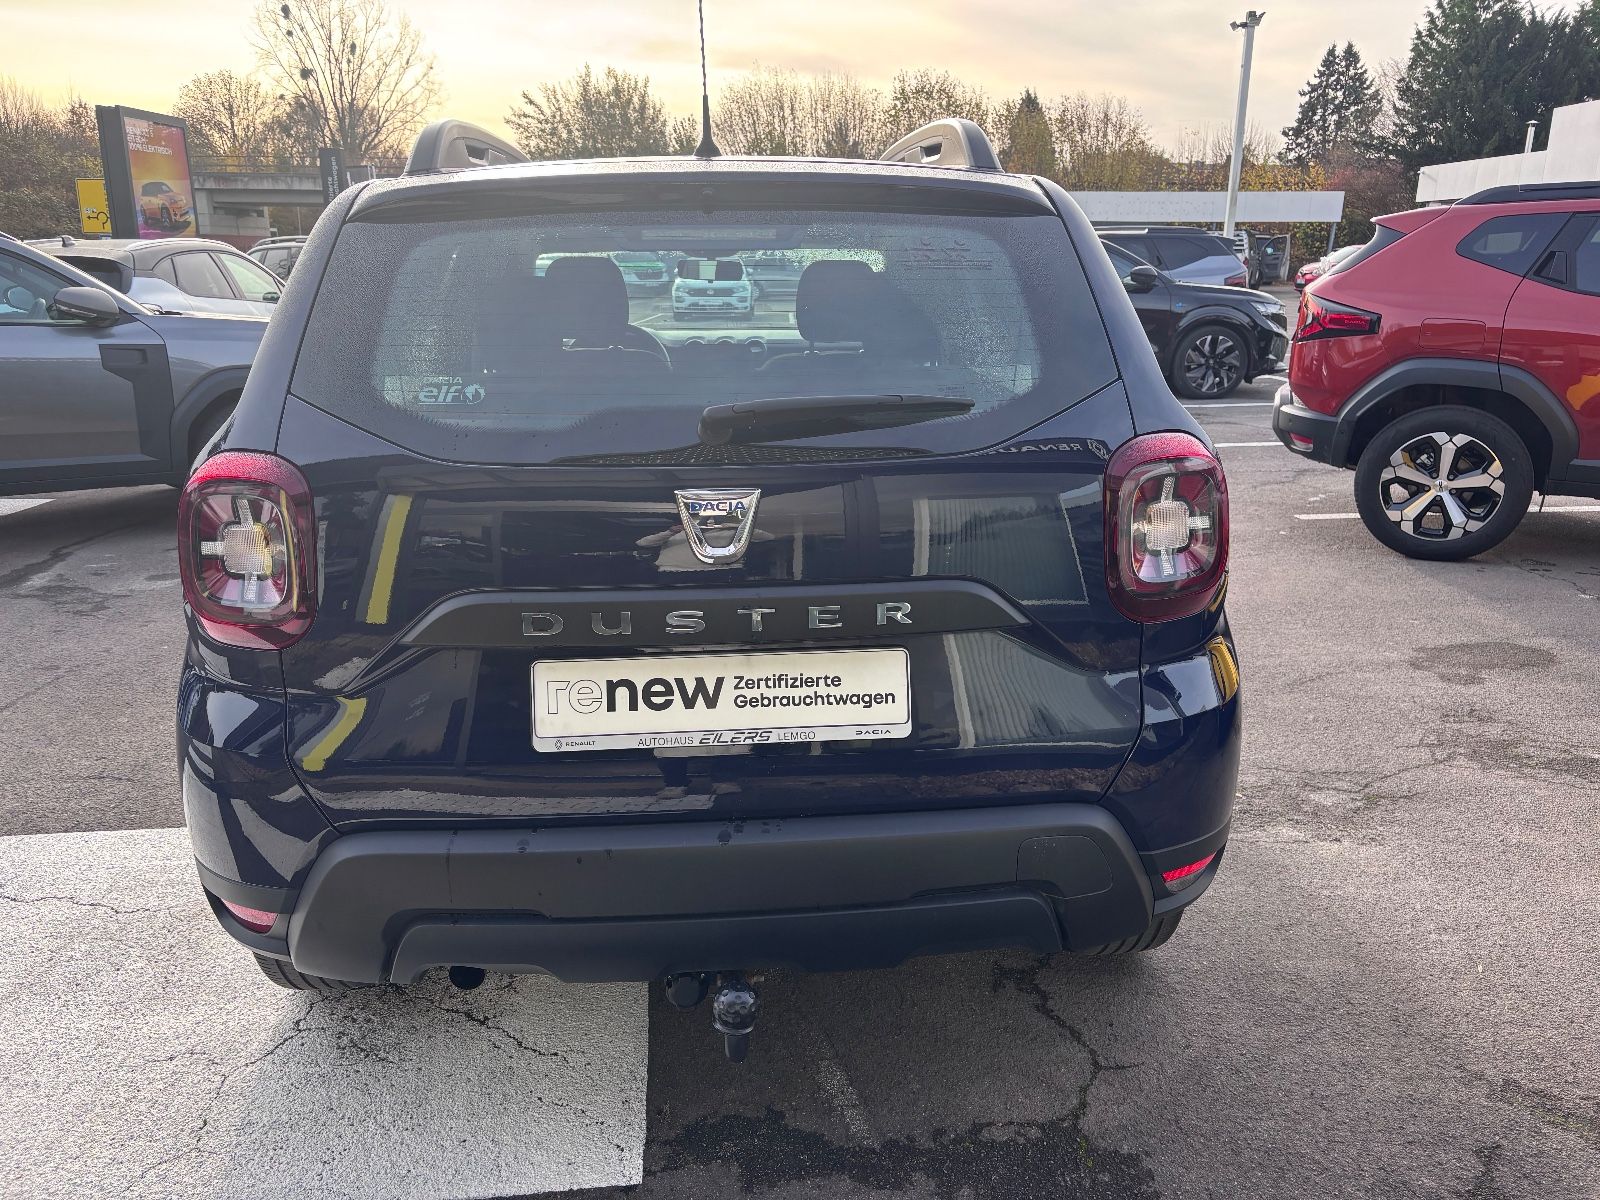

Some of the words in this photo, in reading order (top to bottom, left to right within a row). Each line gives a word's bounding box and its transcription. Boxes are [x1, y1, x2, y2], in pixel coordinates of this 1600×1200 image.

[422, 376, 463, 384] DACIA
[419, 385, 462, 403] elf
[689, 501, 747, 513] DACIA
[522, 602, 913, 636] DUSTER
[733, 673, 842, 690] Zertifizierte
[547, 677, 726, 714] renew
[733, 691, 896, 709] Gebrauchtwagen
[637, 736, 694, 748] AUTOHAUS
[698, 731, 773, 745] EILERS
[777, 731, 816, 741] LEMGO
